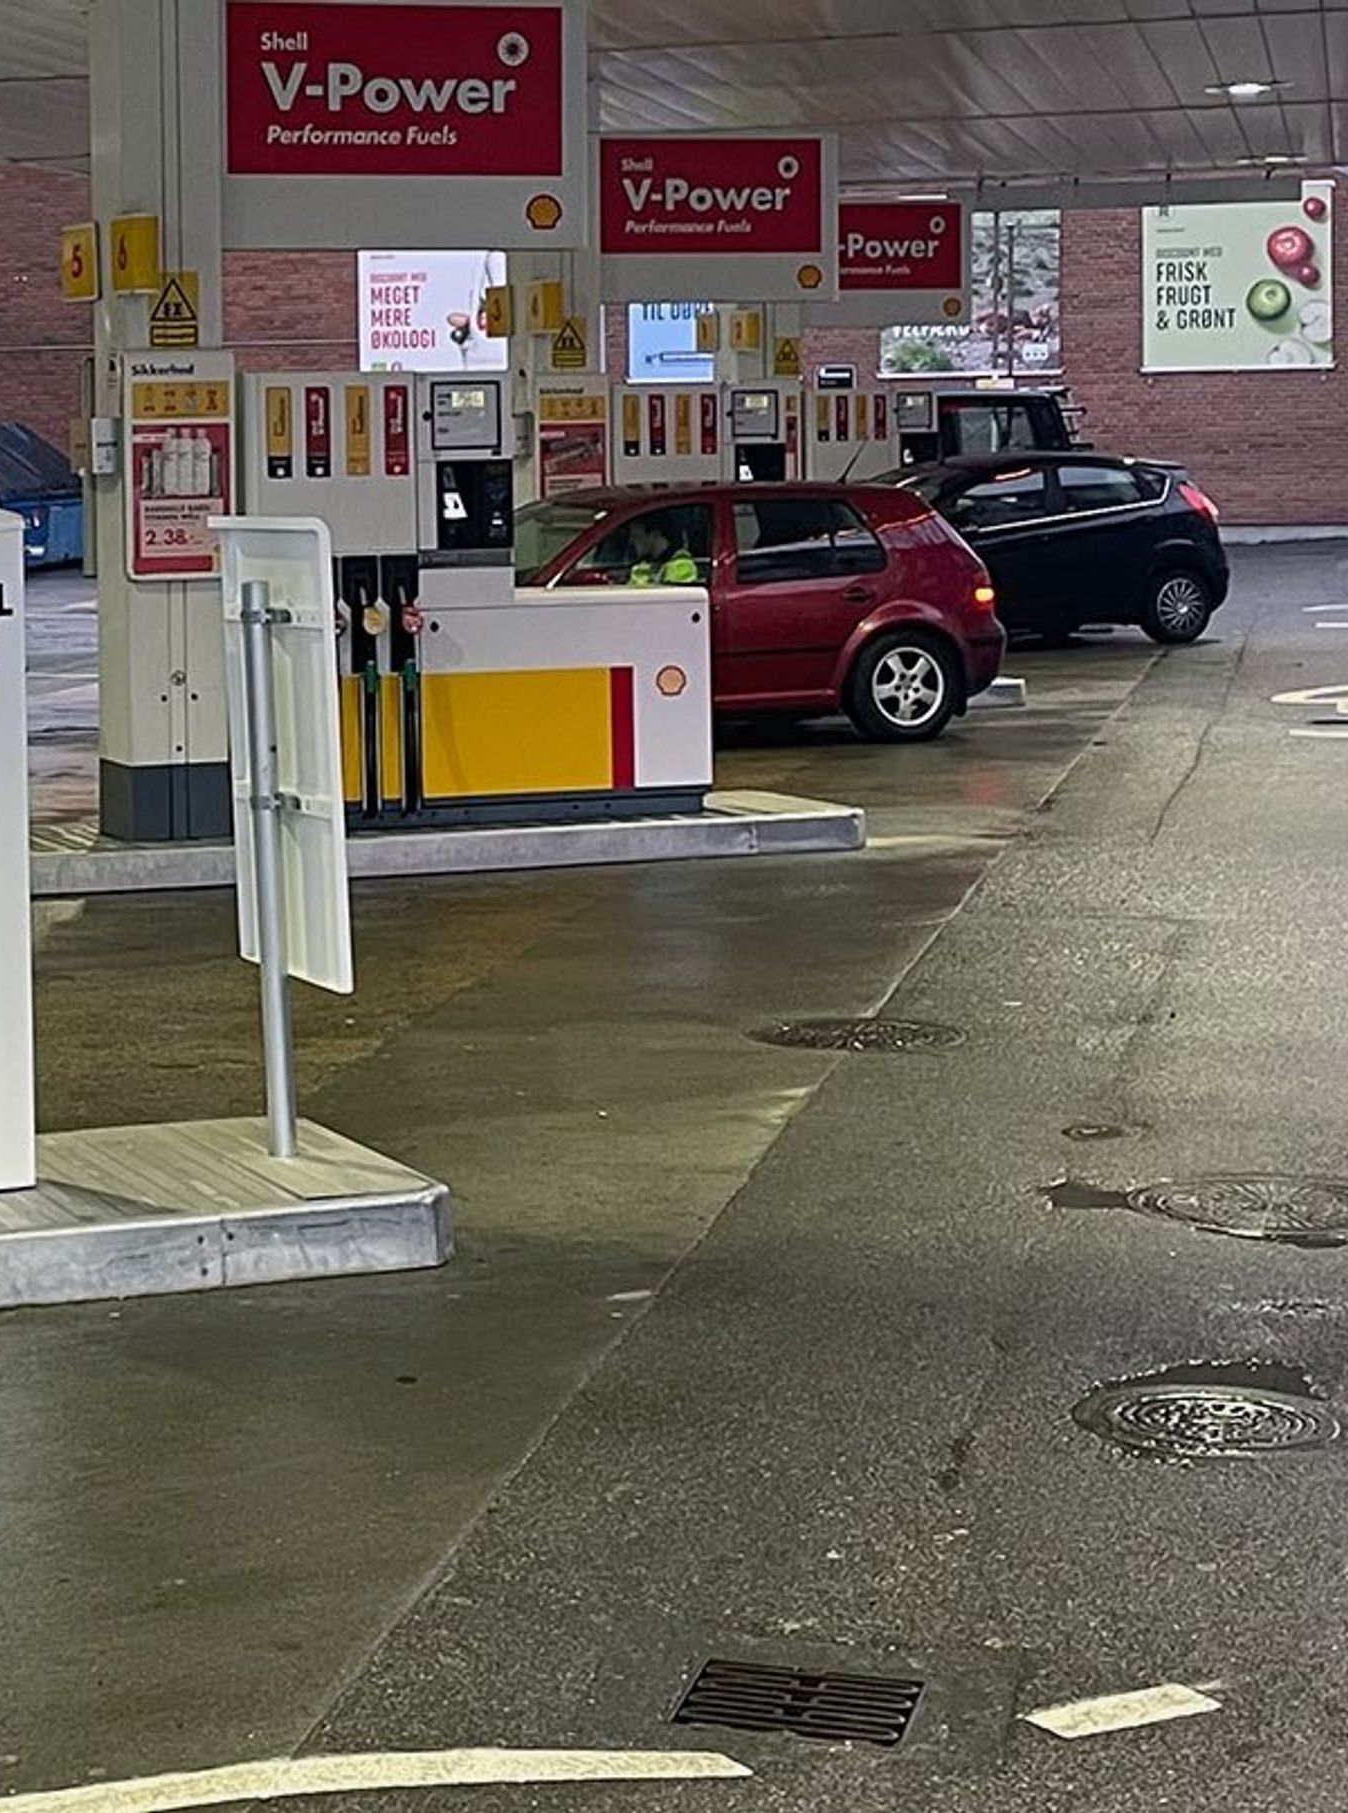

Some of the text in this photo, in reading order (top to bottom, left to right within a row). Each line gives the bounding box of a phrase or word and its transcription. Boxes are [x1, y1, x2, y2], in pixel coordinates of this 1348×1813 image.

[260, 31, 308, 52] Shell
[260, 61, 517, 114] V-Power
[267, 124, 458, 146] Performance Fuels
[620, 157, 653, 172] Shell
[622, 177, 791, 212] V-Power
[624, 218, 752, 235] Performance Fuels
[116, 234, 128, 271] 6
[839, 232, 939, 259] -Power
[70, 243, 83, 279] 5
[1156, 262, 1208, 282] FRISK
[370, 285, 420, 305] MEGET
[1156, 285, 1211, 306] FRUGT
[370, 308, 412, 327] MERE
[1155, 308, 1236, 331] & GRØNT
[370, 329, 436, 350] ØKOLOGI
